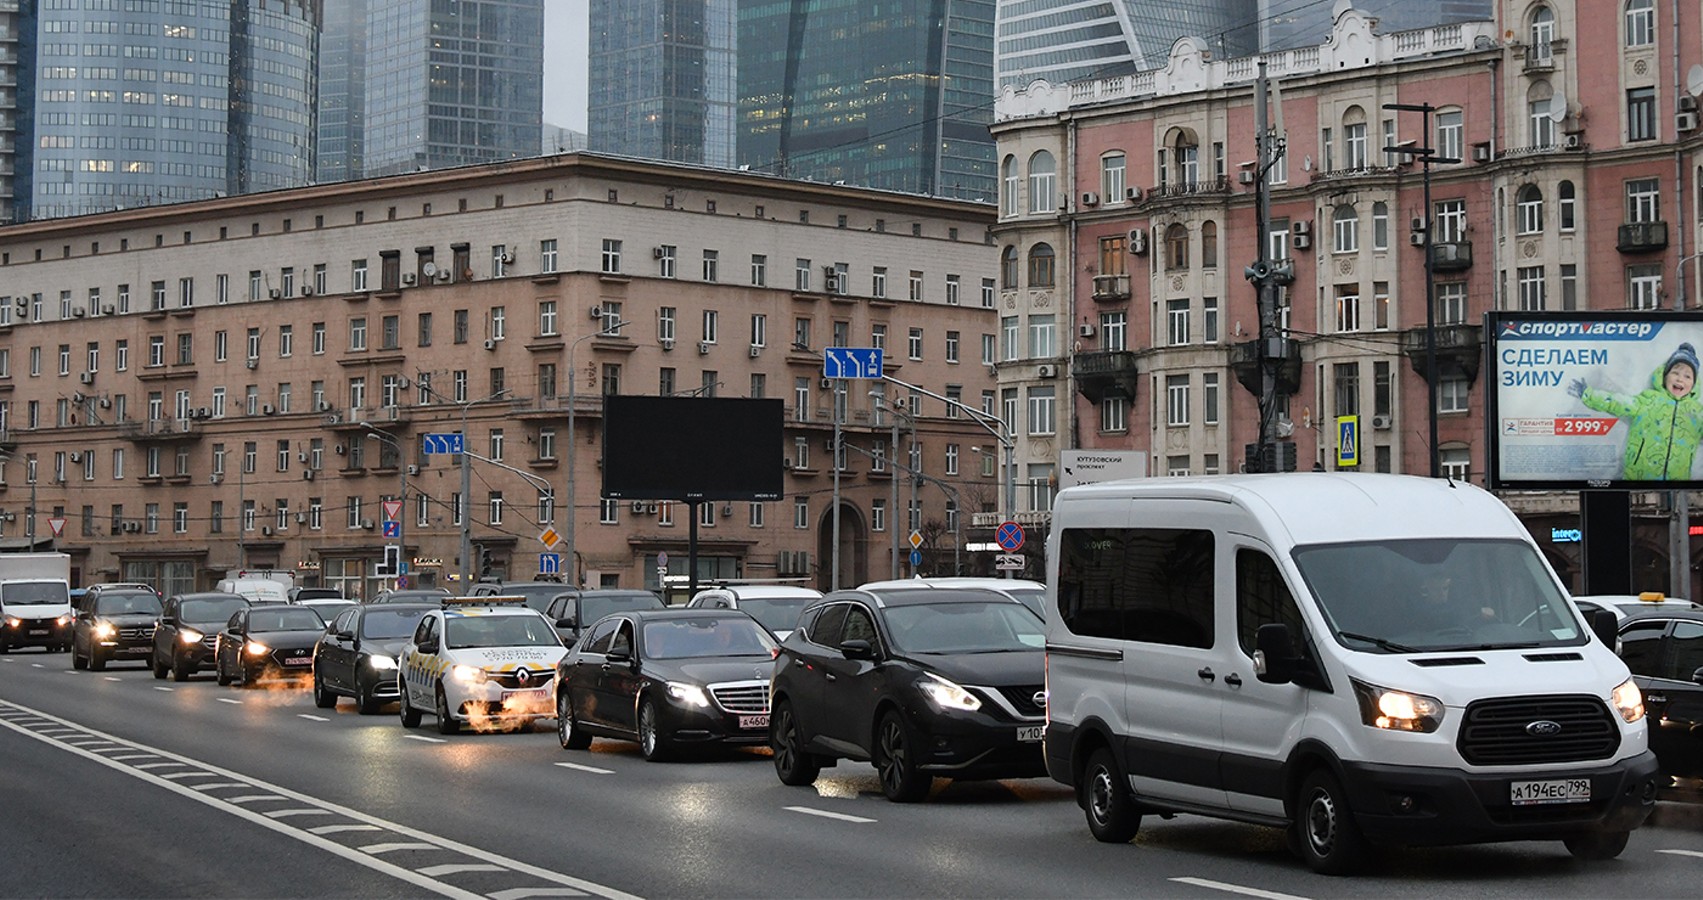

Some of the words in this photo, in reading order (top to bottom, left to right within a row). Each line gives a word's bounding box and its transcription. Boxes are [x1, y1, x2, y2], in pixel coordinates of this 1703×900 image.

[1519, 322, 1651, 337] спортмастер
[1502, 349, 1607, 367] СДЕЛАЕМ
[1502, 371, 1564, 386] ЗИМУ
[743, 716, 769, 726] А460
[1020, 728, 1042, 739] У10
